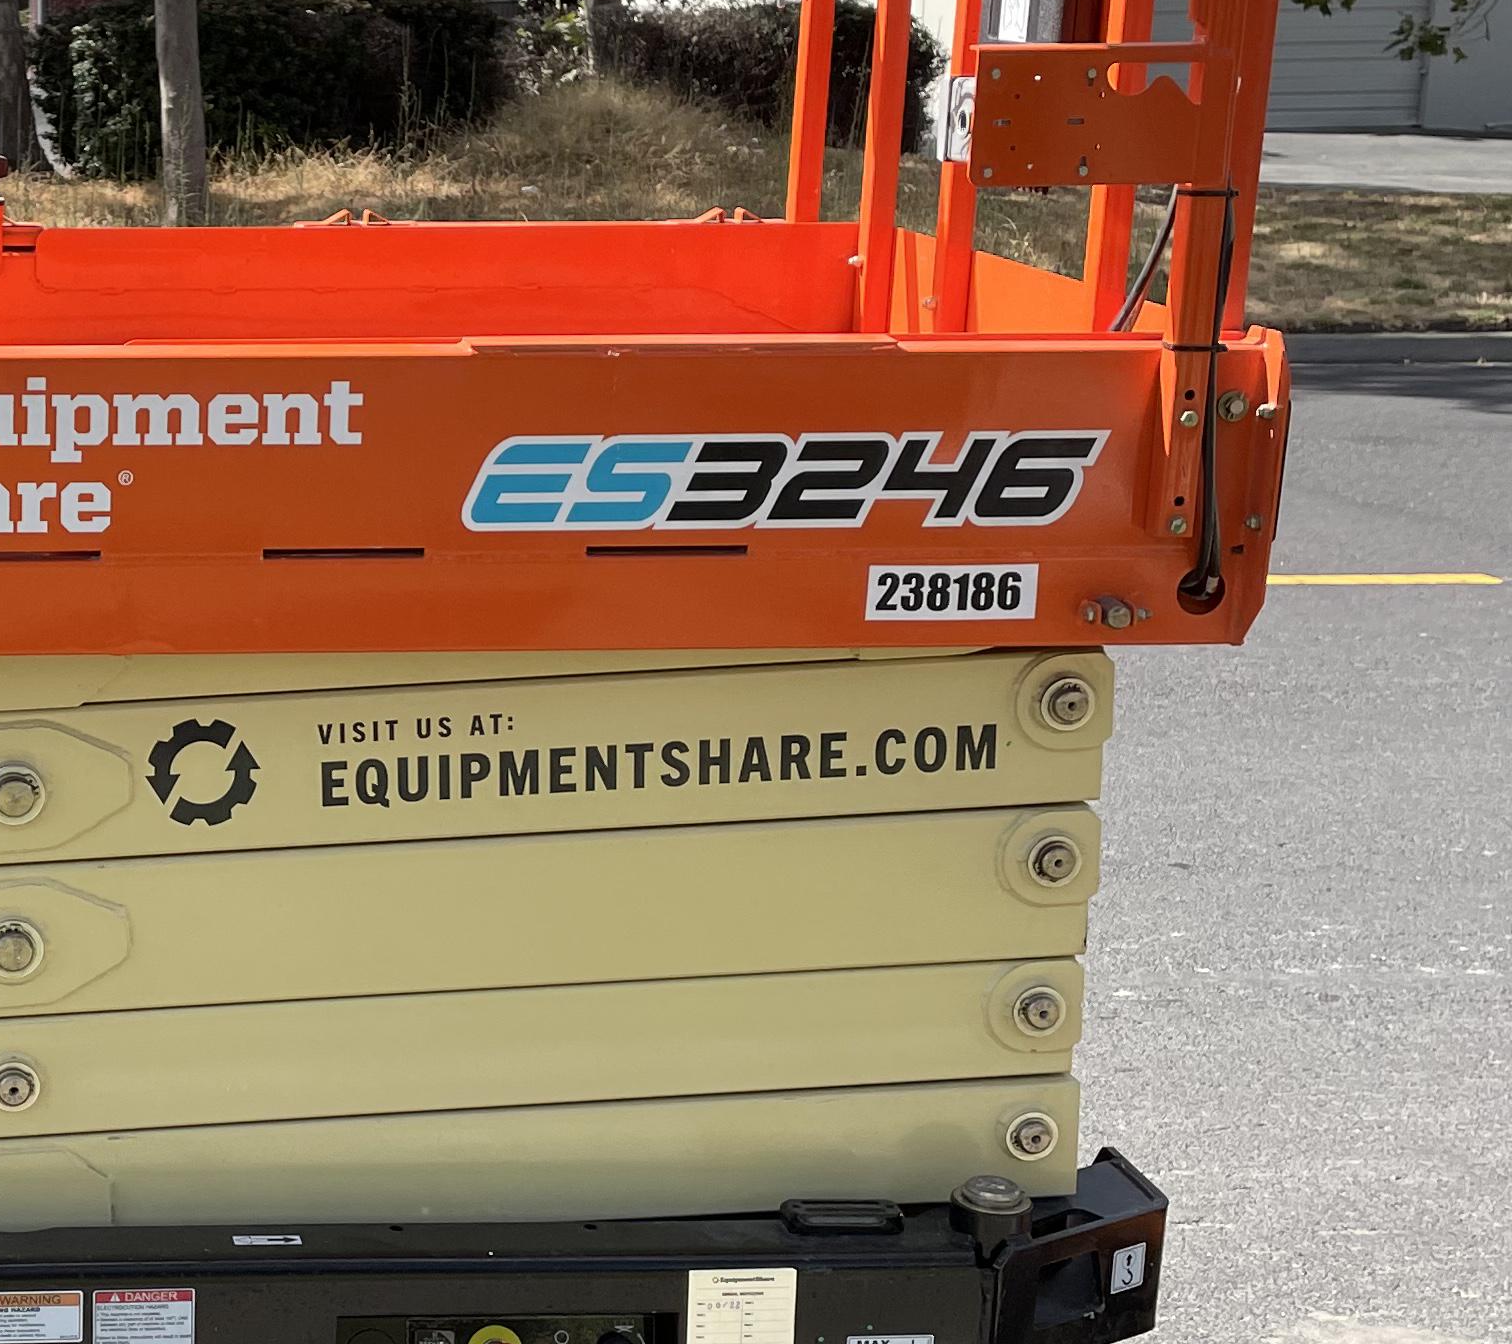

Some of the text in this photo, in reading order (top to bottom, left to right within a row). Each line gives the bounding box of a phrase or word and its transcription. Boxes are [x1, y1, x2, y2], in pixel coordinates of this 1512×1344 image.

[464, 432, 1108, 528] ES3246
[875, 571, 1022, 612] 238186
[317, 713, 515, 745] VISIT US AT:
[320, 723, 999, 809] EQUIPMENTSHARE.COM
[0, 1295, 61, 1305] WARNING
[124, 1291, 178, 1302] DANGER
